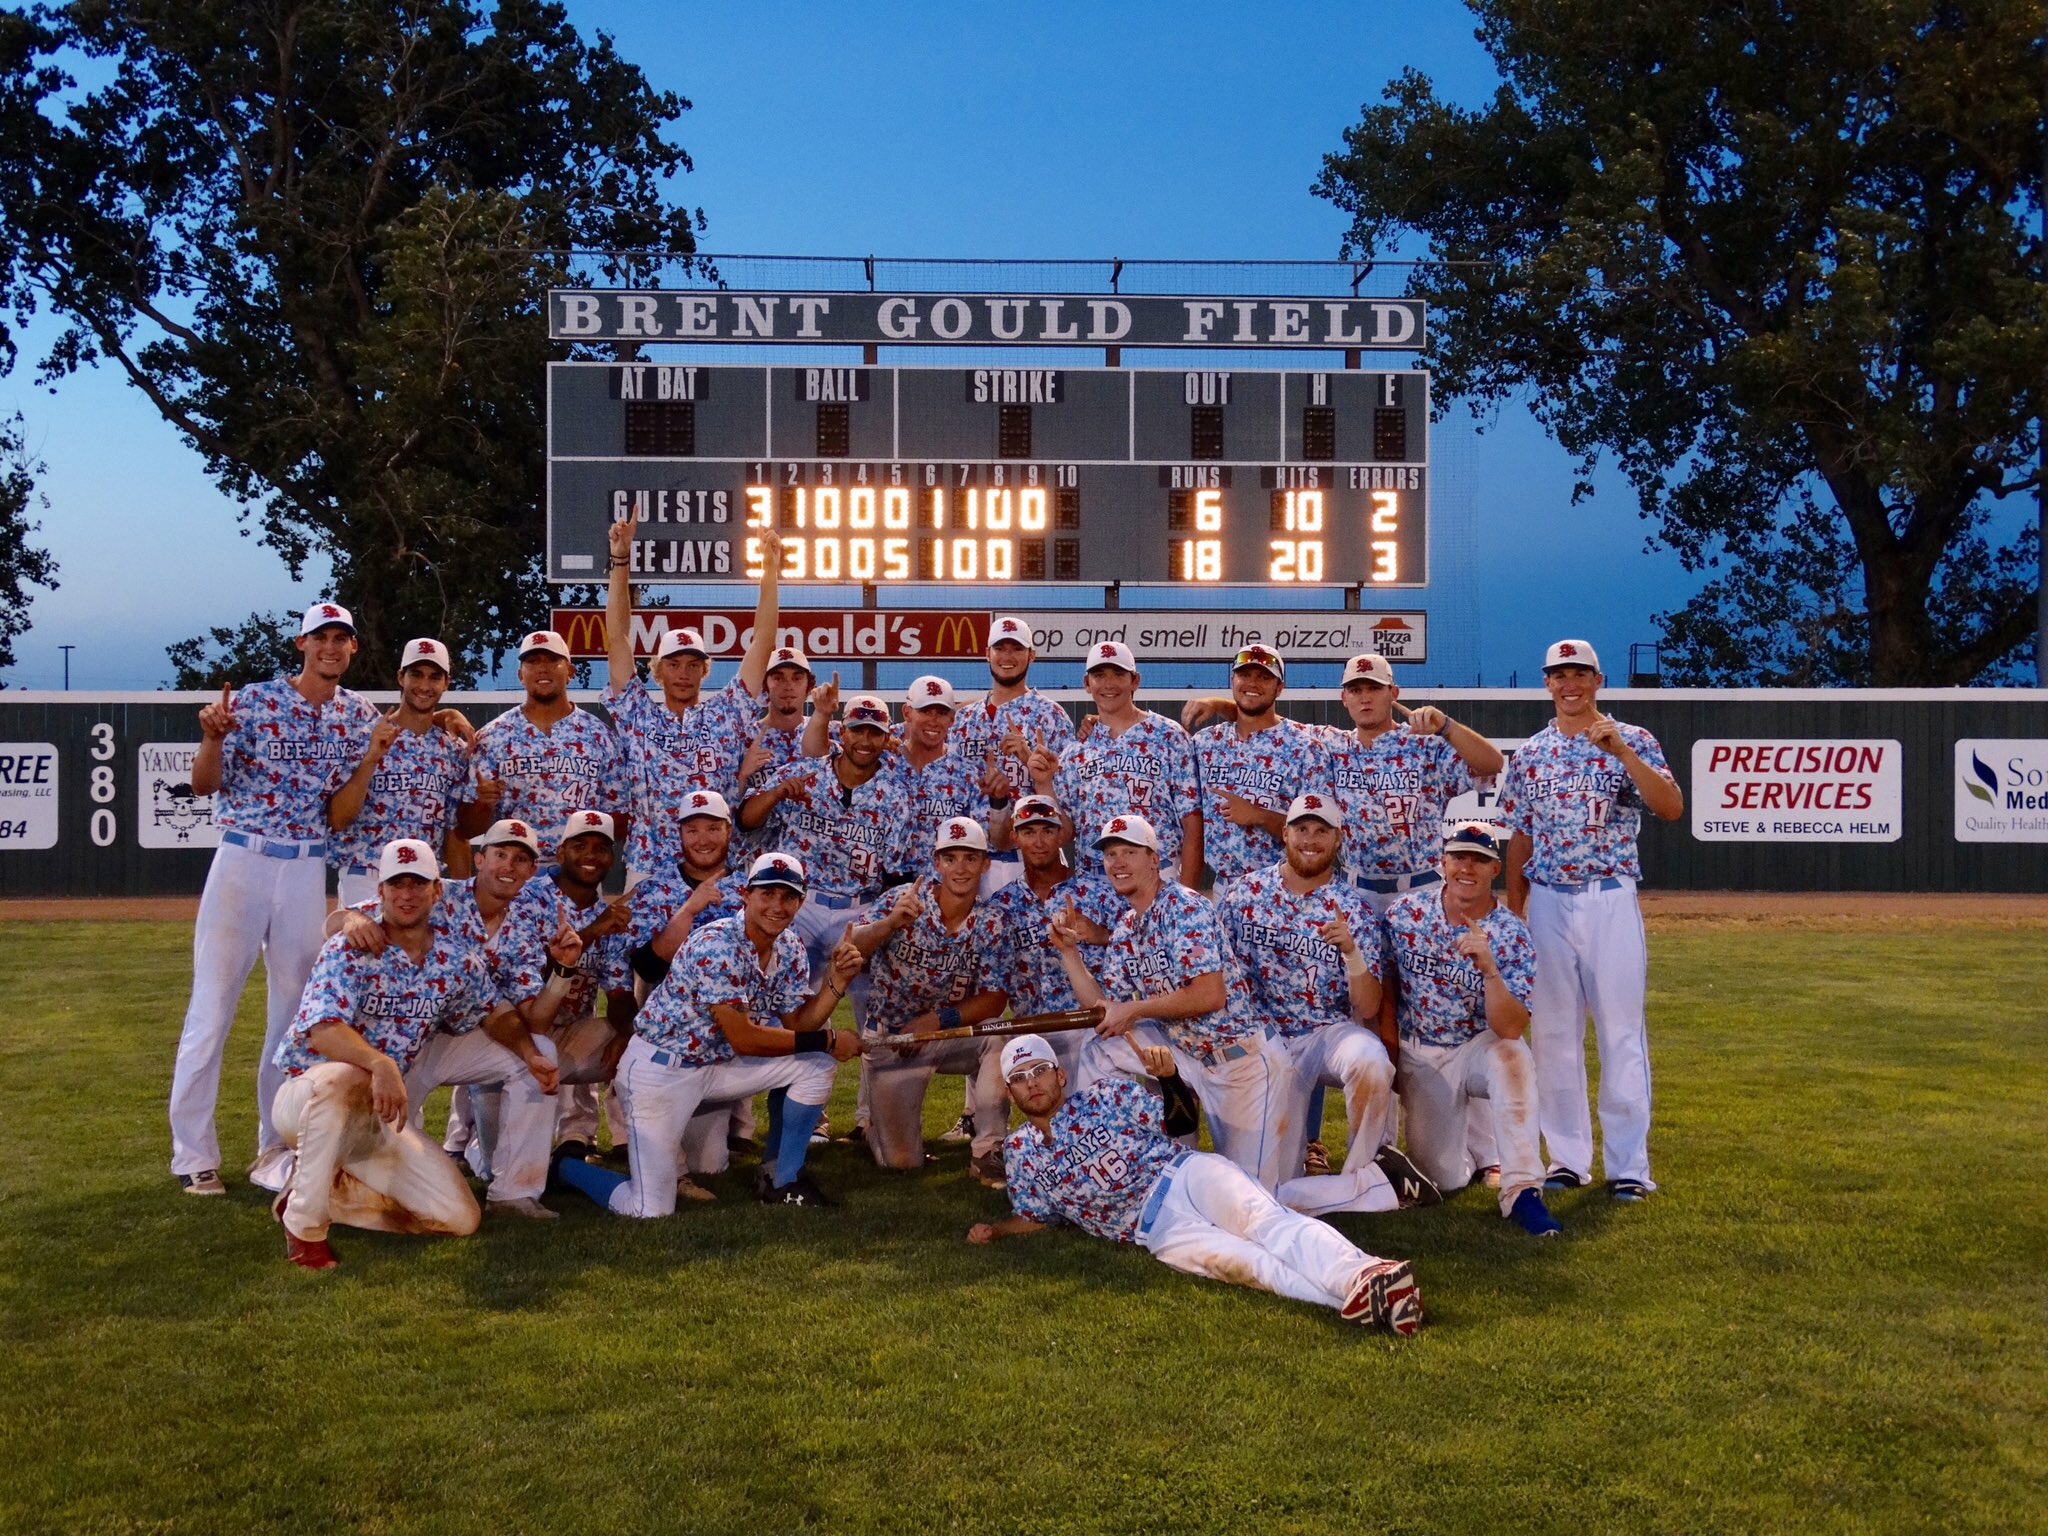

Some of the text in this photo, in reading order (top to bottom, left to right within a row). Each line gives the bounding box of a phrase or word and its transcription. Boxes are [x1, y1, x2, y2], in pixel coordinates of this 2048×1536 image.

[560, 294, 1416, 343] BRENT GOULD FIELD
[621, 367, 698, 400] AT BAT
[806, 369, 859, 401] BALL
[974, 371, 1056, 403] STRIKE
[1185, 373, 1230, 405] OUT
[1312, 374, 1396, 406] H E
[755, 464, 1077, 487] 1 2 3 4 5 6 7 8 9 10
[1171, 467, 1419, 490] RUNS HITS ERRORS
[613, 490, 728, 523] GUESTS
[745, 487, 1397, 532] 3 1 0 0 0 1 1 0 0 6 10 2
[629, 540, 730, 573] EE JAYS
[781, 538, 806, 578] 3
[815, 538, 840, 578] 0
[849, 538, 875, 579] 0
[883, 538, 908, 579] 5
[934, 538, 943, 579] 1
[953, 539, 977, 579] 0
[987, 539, 1011, 579] 0
[1184, 540, 1221, 580] 18
[1270, 540, 1323, 581] 20
[1372, 541, 1397, 581] 3
[631, 614, 922, 654] MDnald's
[1075, 624, 1127, 646] and
[1139, 624, 1207, 648] smell
[1222, 625, 1261, 647] the
[1275, 625, 1351, 650] pizza!
[1373, 630, 1411, 644] Pizza
[1374, 642, 1404, 656] Hut
[142, 749, 196, 773] YANCE
[268, 741, 307, 761] BEE
[1112, 754, 1162, 776] JAYS
[1709, 746, 1885, 774] PRECISION
[0, 755, 52, 784] REE
[504, 756, 599, 778] BEE JAYS
[1234, 767, 1283, 792] JAYS
[1368, 770, 1420, 791] JAYS
[2007, 757, 2048, 787] So
[35, 789, 52, 798] LLC
[90, 723, 117, 847] 380
[373, 772, 452, 793] BEE JAY
[562, 780, 591, 810] 41
[1126, 778, 1155, 807] 17
[1526, 779, 1560, 801] BEE
[1567, 773, 1623, 793] JAYS
[1720, 782, 1873, 810] SERVICES
[800, 812, 836, 837] BEE
[1384, 795, 1419, 826] 27
[1586, 797, 1610, 828] 11
[1704, 822, 1890, 834] STEVE & REBECCA HELM
[1965, 817, 2008, 833] Quality
[896, 941, 932, 969] BEE
[1242, 923, 1339, 963] BEE JAYS
[1403, 949, 1483, 992] BEE JAY
[949, 974, 970, 1002] 5
[362, 993, 450, 1018] BEE JAY
[982, 1020, 1013, 1032] DINGER
[1065, 1124, 1111, 1174] JAYS
[1088, 1149, 1128, 1191] 16
